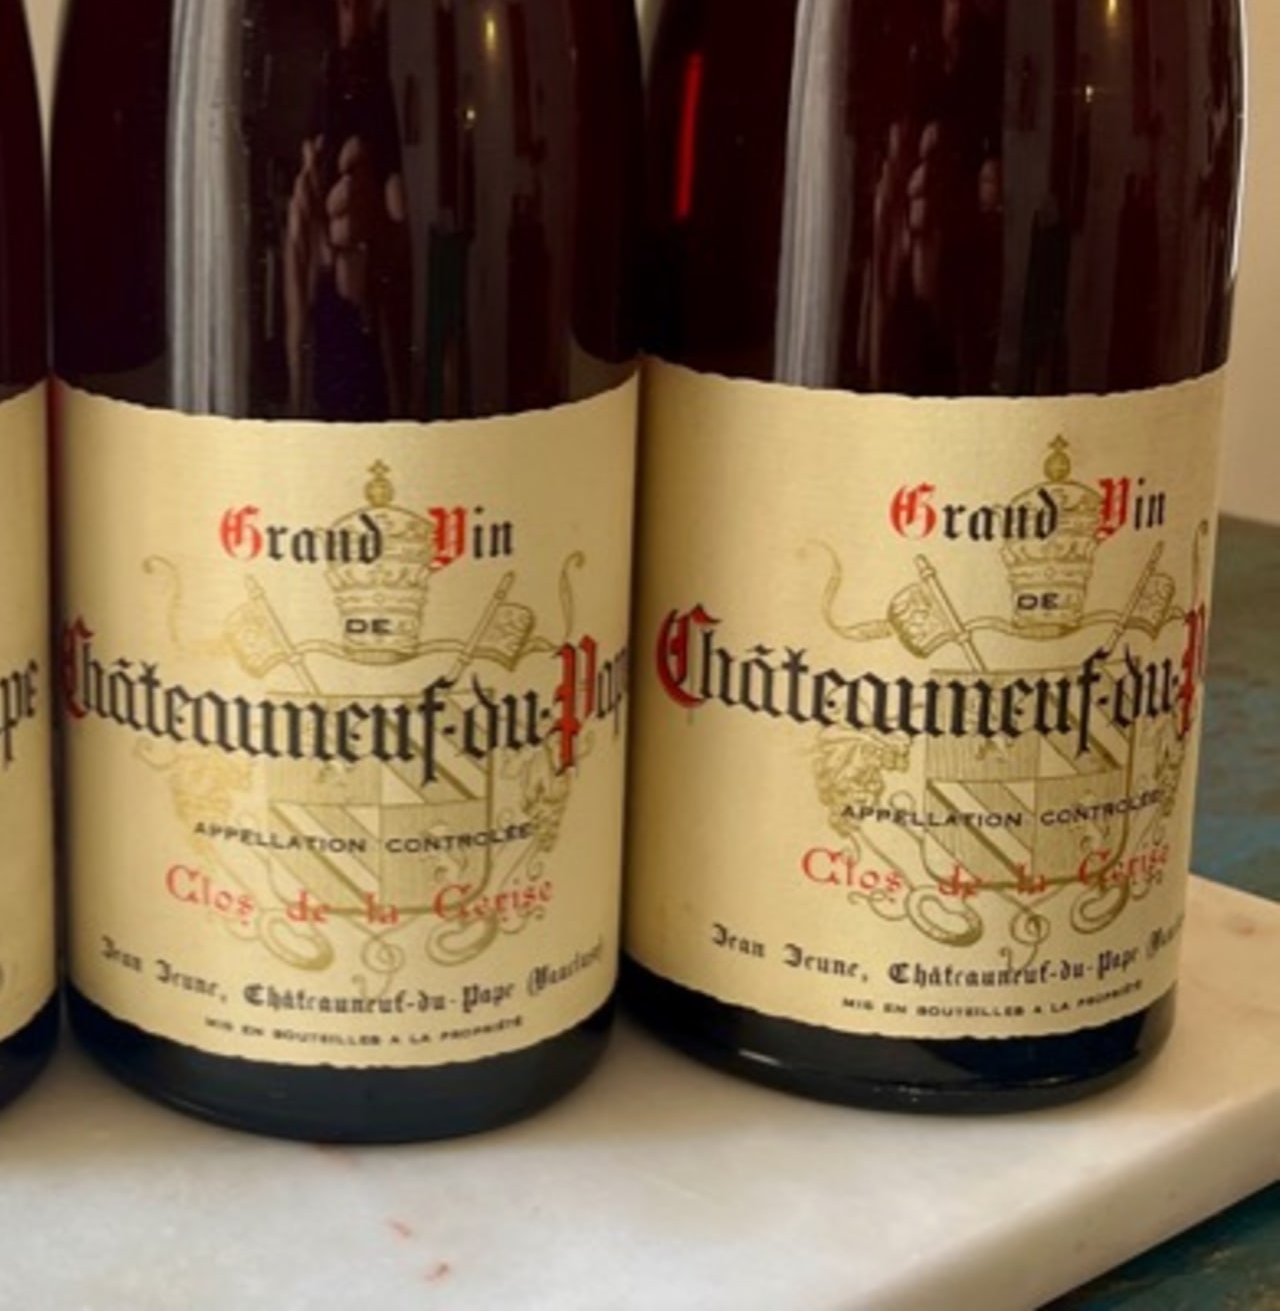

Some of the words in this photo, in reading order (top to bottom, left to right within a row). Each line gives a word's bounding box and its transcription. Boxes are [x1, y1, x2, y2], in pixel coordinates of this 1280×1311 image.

[889, 483, 1059, 541] Grand
[1098, 477, 1166, 541] Vin
[220, 505, 383, 565] Grand
[428, 506, 514, 569] Vin
[1017, 594, 1059, 611] DE
[345, 618, 393, 636] DE
[841, 805, 1022, 827] APPELLATION
[194, 821, 367, 854] APPELLATION
[801, 847, 903, 899] Clos
[938, 864, 983, 897] de
[1017, 862, 1047, 893] la
[165, 864, 255, 925] Clos
[286, 890, 331, 925] de
[366, 892, 400, 926] la
[433, 881, 554, 926] Cerise
[712, 923, 765, 957] Jean
[785, 943, 869, 983] Jeune,
[842, 998, 874, 1011] MIS
[883, 1003, 907, 1015] EN
[917, 1005, 1025, 1017] BOUTEILLES
[1051, 1002, 1071, 1013] LA
[241, 1024, 263, 1037] EN
[273, 1028, 380, 1046] BOUTEILLES
[409, 1034, 429, 1044] LA
